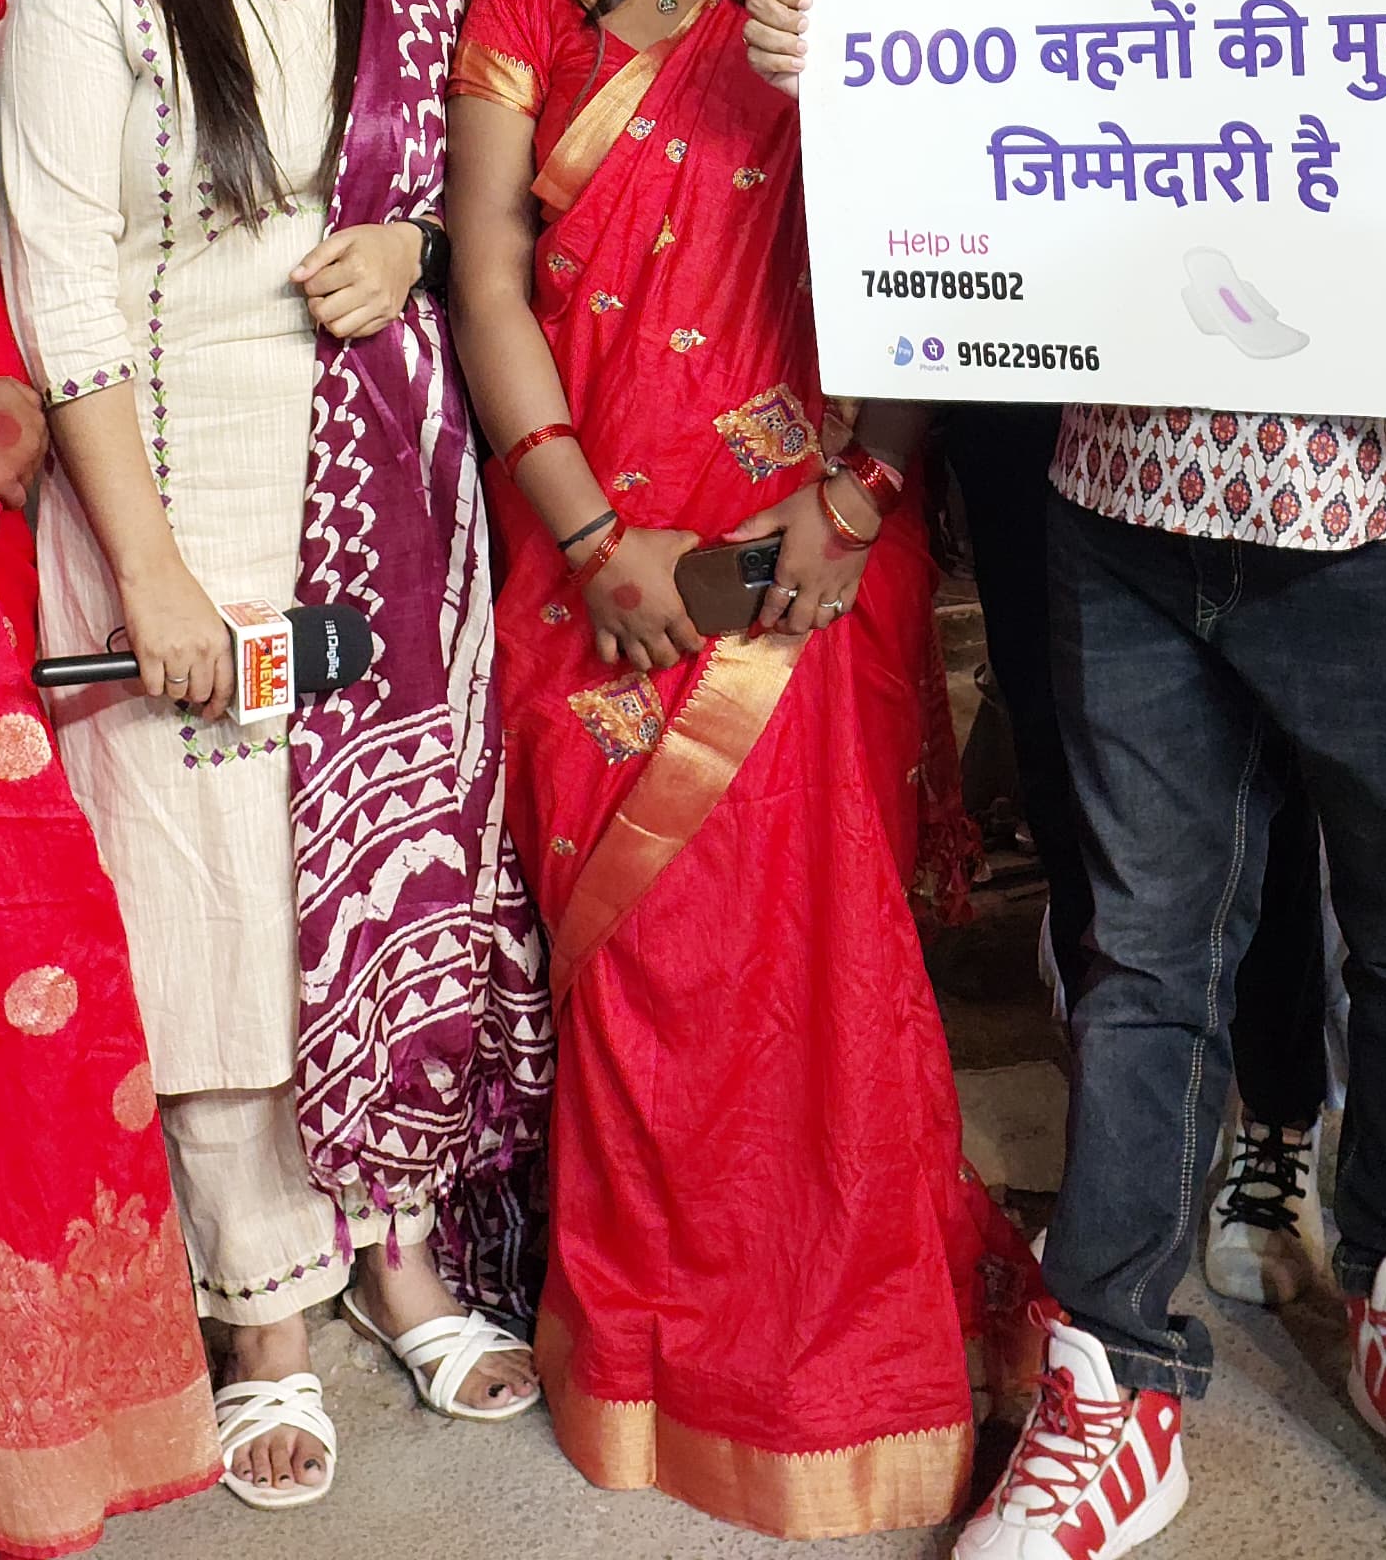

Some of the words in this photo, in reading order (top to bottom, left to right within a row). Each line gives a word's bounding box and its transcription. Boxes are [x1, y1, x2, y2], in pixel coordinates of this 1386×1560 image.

[843, 26, 1017, 88] 5000
[987, 120, 1273, 208] जिम्मेदारी
[1292, 114, 1341, 213] है
[888, 229, 950, 257] Help
[959, 233, 990, 255] us
[861, 269, 1025, 301] 7488788502
[957, 341, 1101, 371] 9162296766
[260, 654, 273, 708] NEWS
